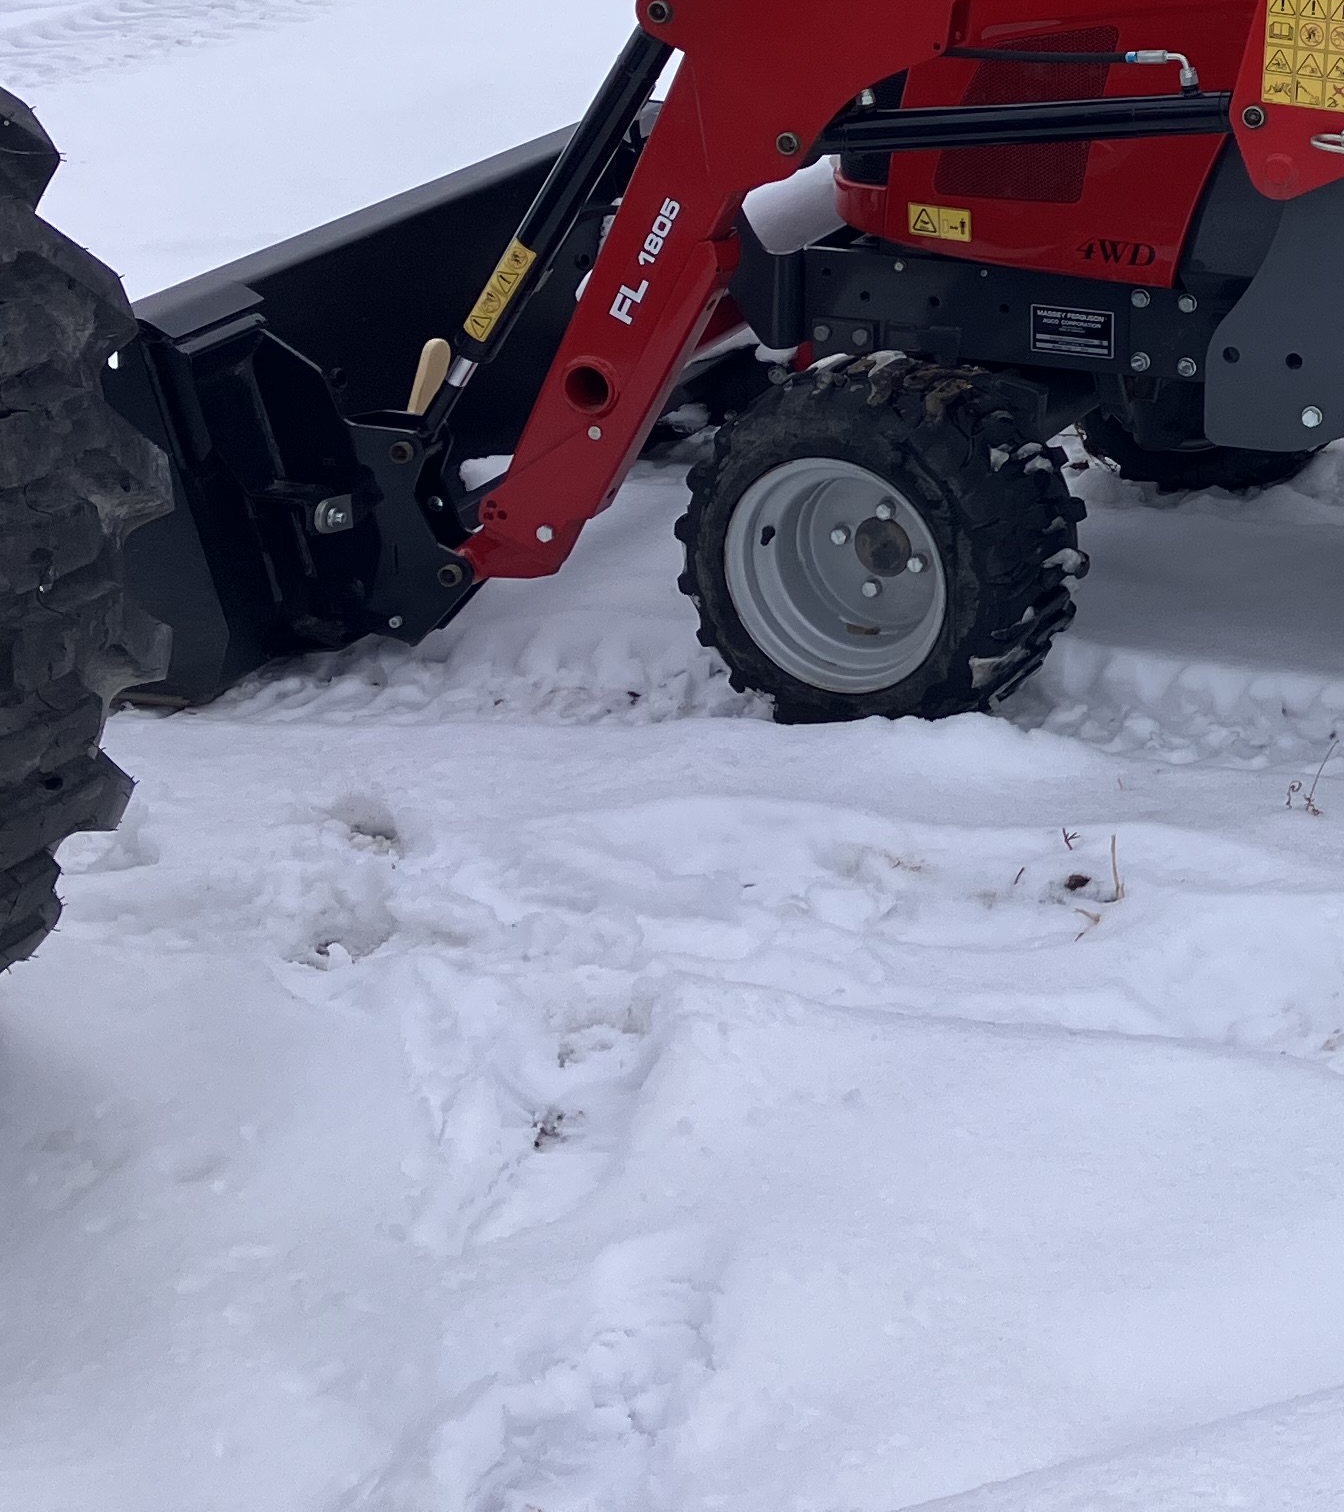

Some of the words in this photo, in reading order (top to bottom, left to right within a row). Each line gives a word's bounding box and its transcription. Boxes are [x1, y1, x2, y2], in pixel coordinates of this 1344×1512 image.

[608, 278, 650, 326] FL
[637, 196, 681, 266] 1805
[1075, 235, 1157, 266] 4WD
